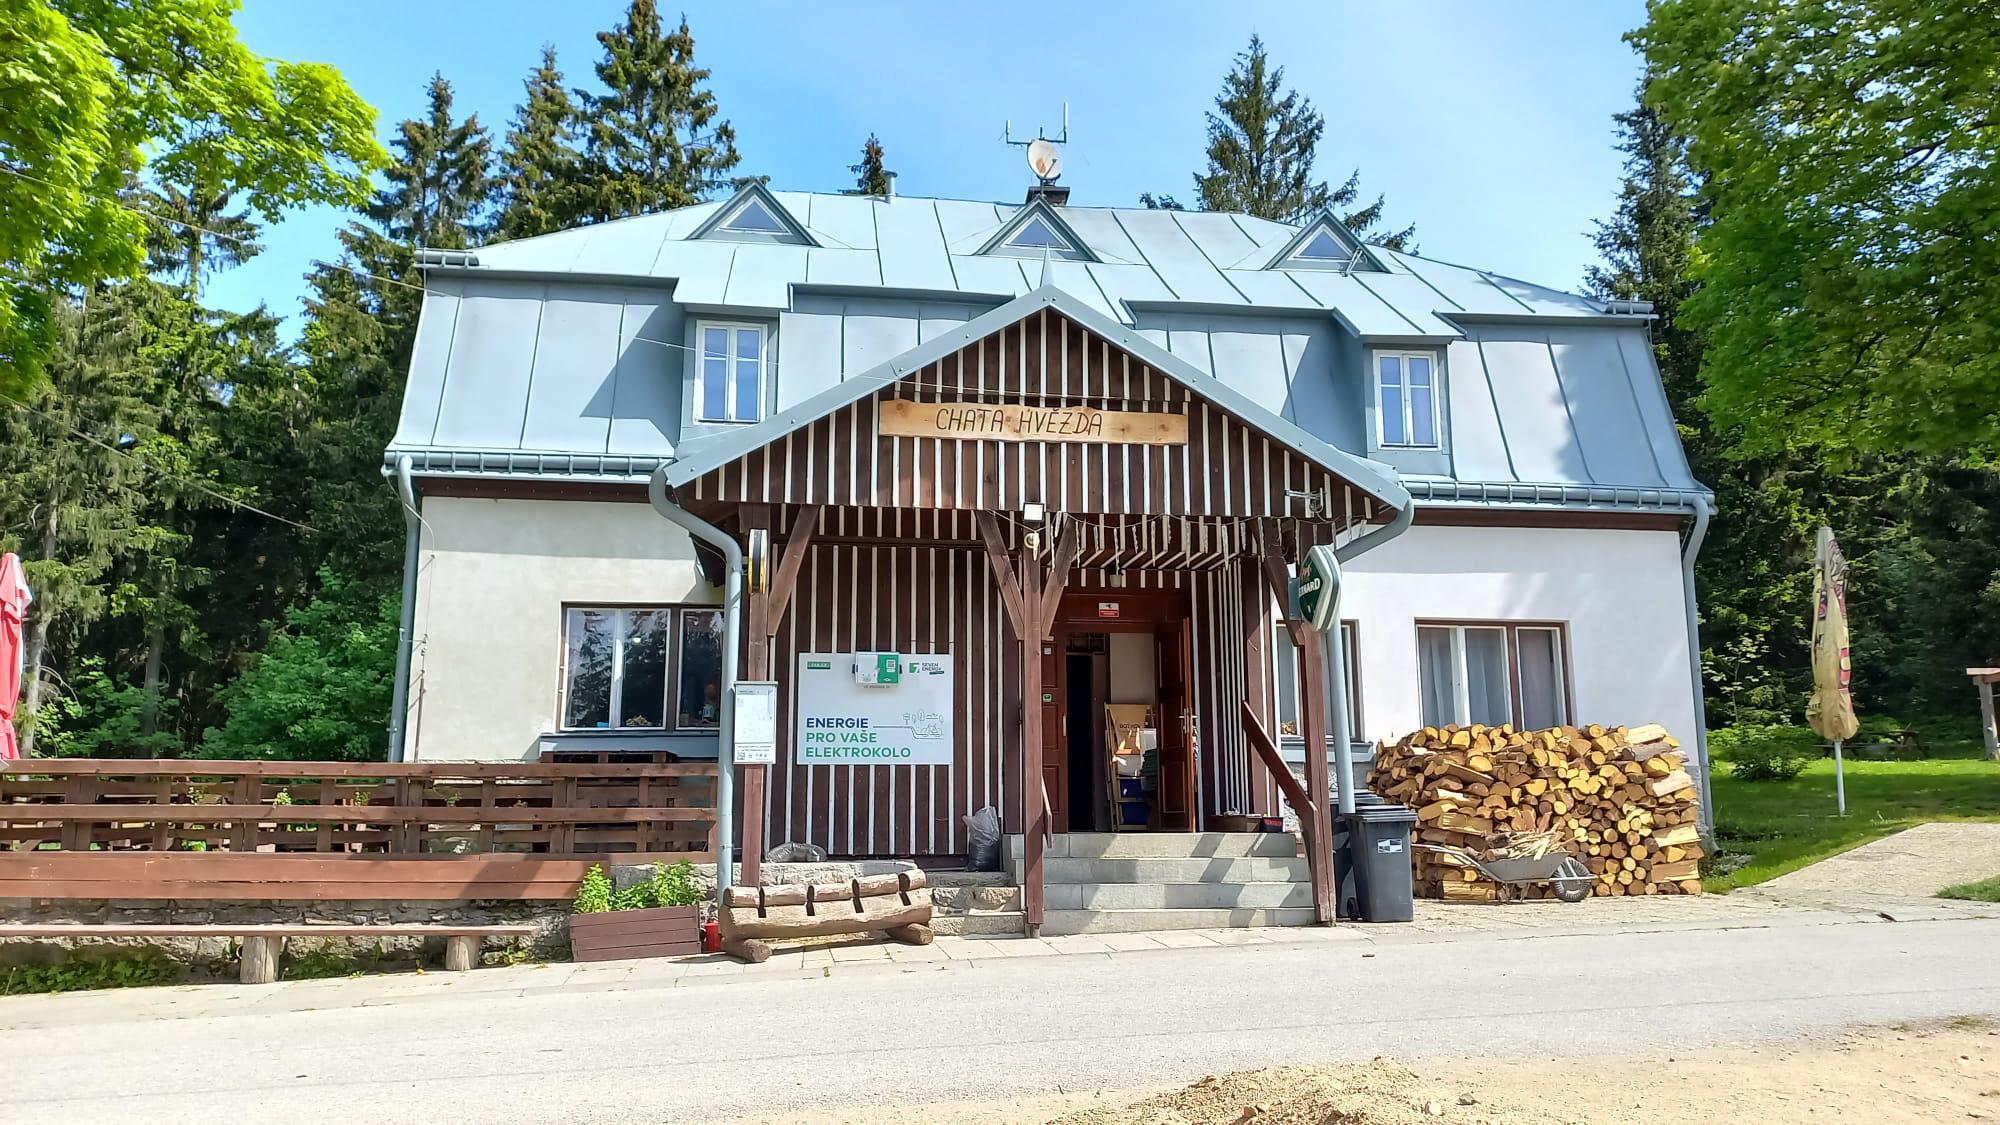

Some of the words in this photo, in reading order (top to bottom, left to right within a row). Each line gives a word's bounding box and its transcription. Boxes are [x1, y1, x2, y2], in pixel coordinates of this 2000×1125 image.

[936, 408, 1004, 432] CHATA
[1018, 408, 1102, 436] HVĚZDA
[806, 718, 869, 728] ENERGIE
[806, 732, 836, 743] PRO
[841, 729, 877, 743] VAŠE
[806, 747, 911, 758] ELEKTROKOLO
